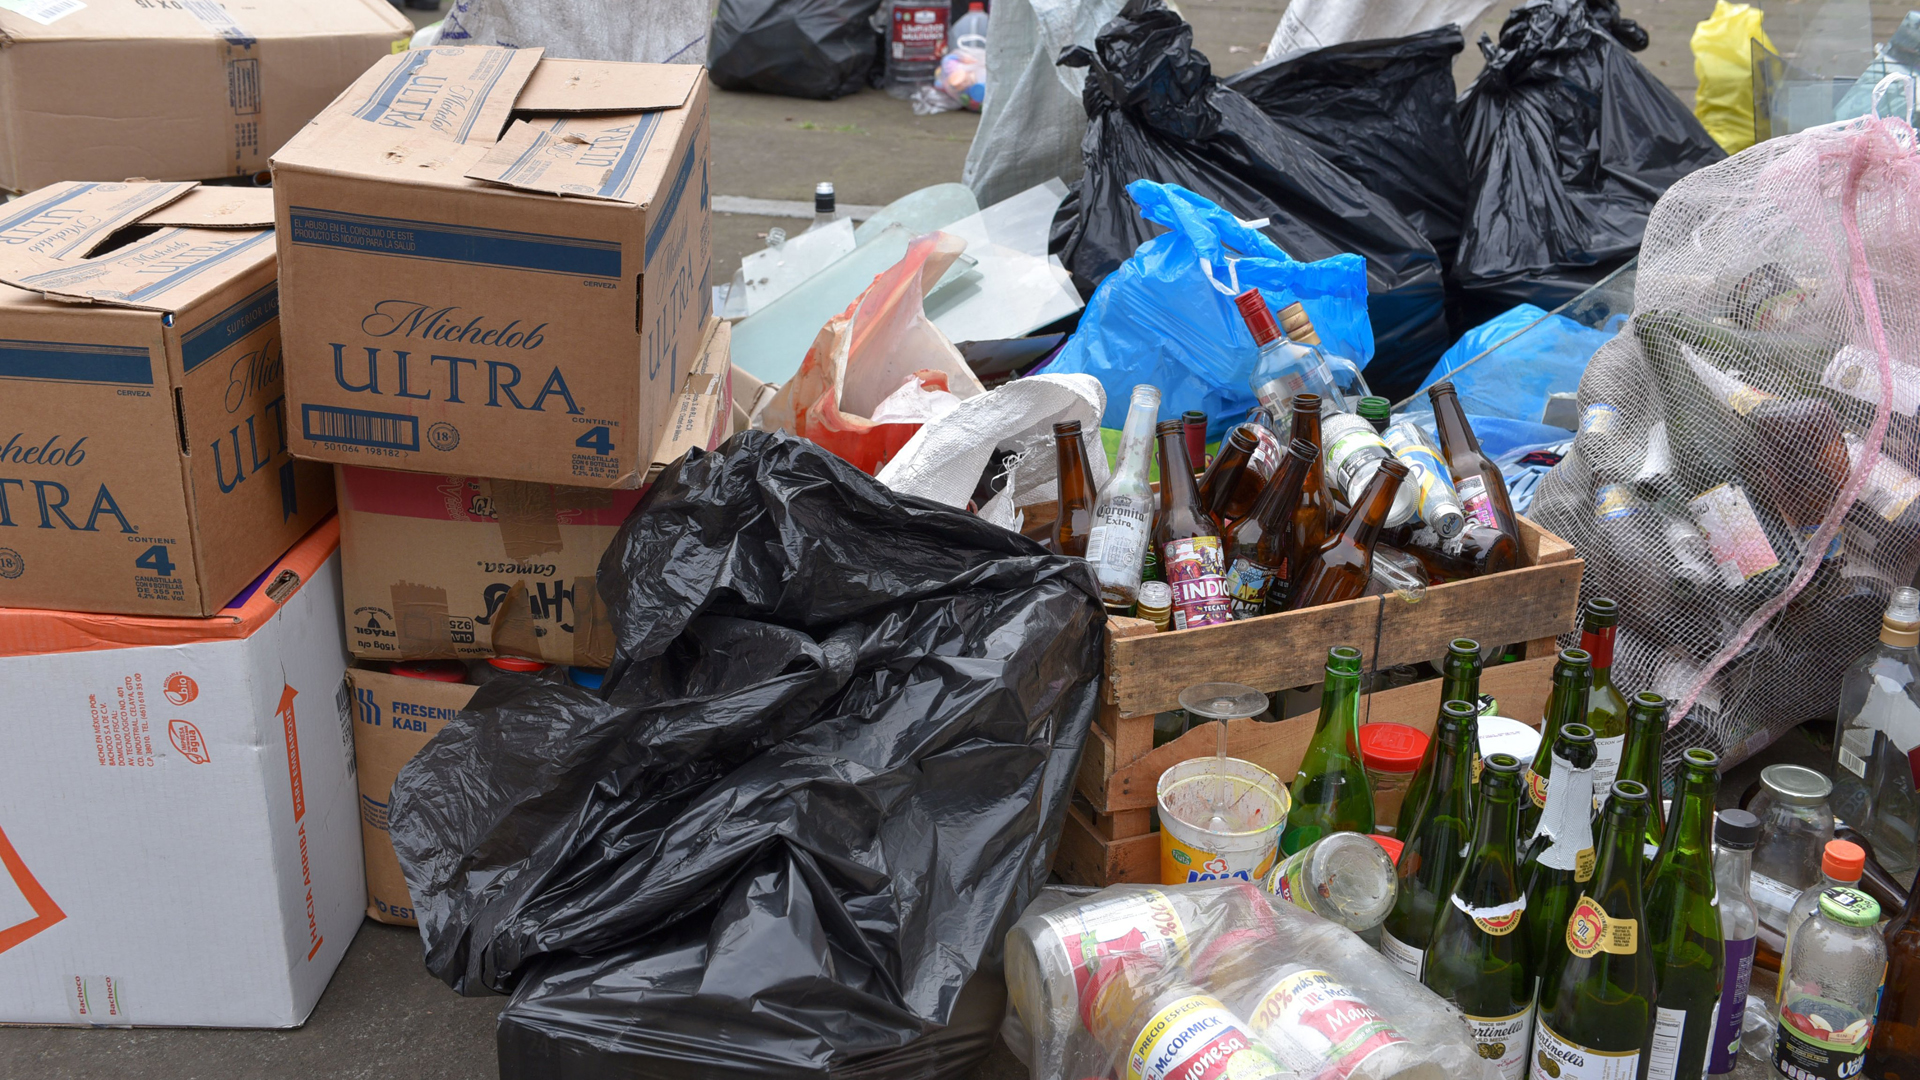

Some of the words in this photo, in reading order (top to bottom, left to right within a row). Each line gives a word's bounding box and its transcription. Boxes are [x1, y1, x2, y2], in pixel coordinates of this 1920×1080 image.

[379, 75, 449, 130] ULTRA
[575, 123, 635, 168] ULTRA
[294, 218, 303, 228] EL
[304, 220, 328, 230] ABUSO
[329, 222, 339, 232] EN
[340, 224, 349, 234] EL
[349, 225, 385, 238] CONSUMO
[386, 229, 396, 240] DE
[397, 231, 414, 241] ESTE
[294, 228, 330, 241] PRODUCTO
[331, 232, 340, 242] ES
[341, 234, 364, 245] NOCIVO
[365, 237, 383, 248] PARA
[384, 239, 393, 249] LA
[393, 240, 416, 251] SALUD
[135, 238, 249, 274] ULTRA
[583, 280, 618, 290] CERVEZA
[226, 306, 263, 337] SUPERIOR
[361, 299, 550, 351] Michelob
[648, 248, 694, 381] ULTRA
[327, 342, 584, 416] ULTRA
[117, 389, 152, 398] CERVEZA
[572, 417, 620, 427] CONTIENE
[0, 432, 88, 467] helob
[324, 442, 360, 454] 501064
[364, 447, 400, 458] 198182
[575, 426, 615, 456] 4
[572, 454, 619, 463] CANASTILLAS
[589, 460, 619, 469] BOTELLAS
[1096, 504, 1145, 522] Coronita
[1105, 515, 1132, 528] Extra
[127, 536, 177, 544] CONTIENE
[135, 545, 176, 576] 4
[484, 562, 557, 577] Gamesa
[135, 576, 183, 584] CANASTILLAS
[153, 582, 184, 590] BOTELLAS
[1182, 579, 1231, 600] INDIO
[1203, 604, 1227, 612] TECATE
[353, 626, 397, 638] FRÁGIL
[357, 640, 372, 649] c/u
[373, 640, 396, 651] 150g
[125, 676, 133, 691] GTO
[134, 673, 141, 682] 00
[177, 678, 188, 695] bio
[137, 692, 145, 703] 618
[91, 709, 101, 734] MÉXICO
[101, 715, 109, 724] DE
[111, 710, 120, 733] FISCAL:
[139, 704, 147, 720] (461)
[120, 711, 133, 755] TECNOLÓGICO
[141, 721, 149, 732] TEL.
[392, 717, 427, 733] KABI
[95, 735, 102, 743] EN
[189, 730, 200, 753] agua
[285, 706, 299, 779] EMBARQUE
[97, 745, 106, 766] HECHO
[105, 735, 116, 766] BACHOCO
[114, 734, 125, 766] DOMICILIO
[137, 756, 145, 767] CD.
[292, 780, 302, 812] PARA
[298, 821, 311, 887] ARRIBA
[1173, 849, 1191, 866] Fruta
[305, 887, 318, 944] HACIA
[75, 975, 87, 1016] Bachoco
[105, 976, 117, 1016] Bachoco
[1259, 988, 1293, 1028] 20%
[1138, 1020, 1166, 1056] PRECIO
[1164, 1000, 1208, 1023] ESPECIAL
[1473, 1019, 1524, 1039] artinelli's
[1154, 1014, 1224, 1074] McCORMICK
